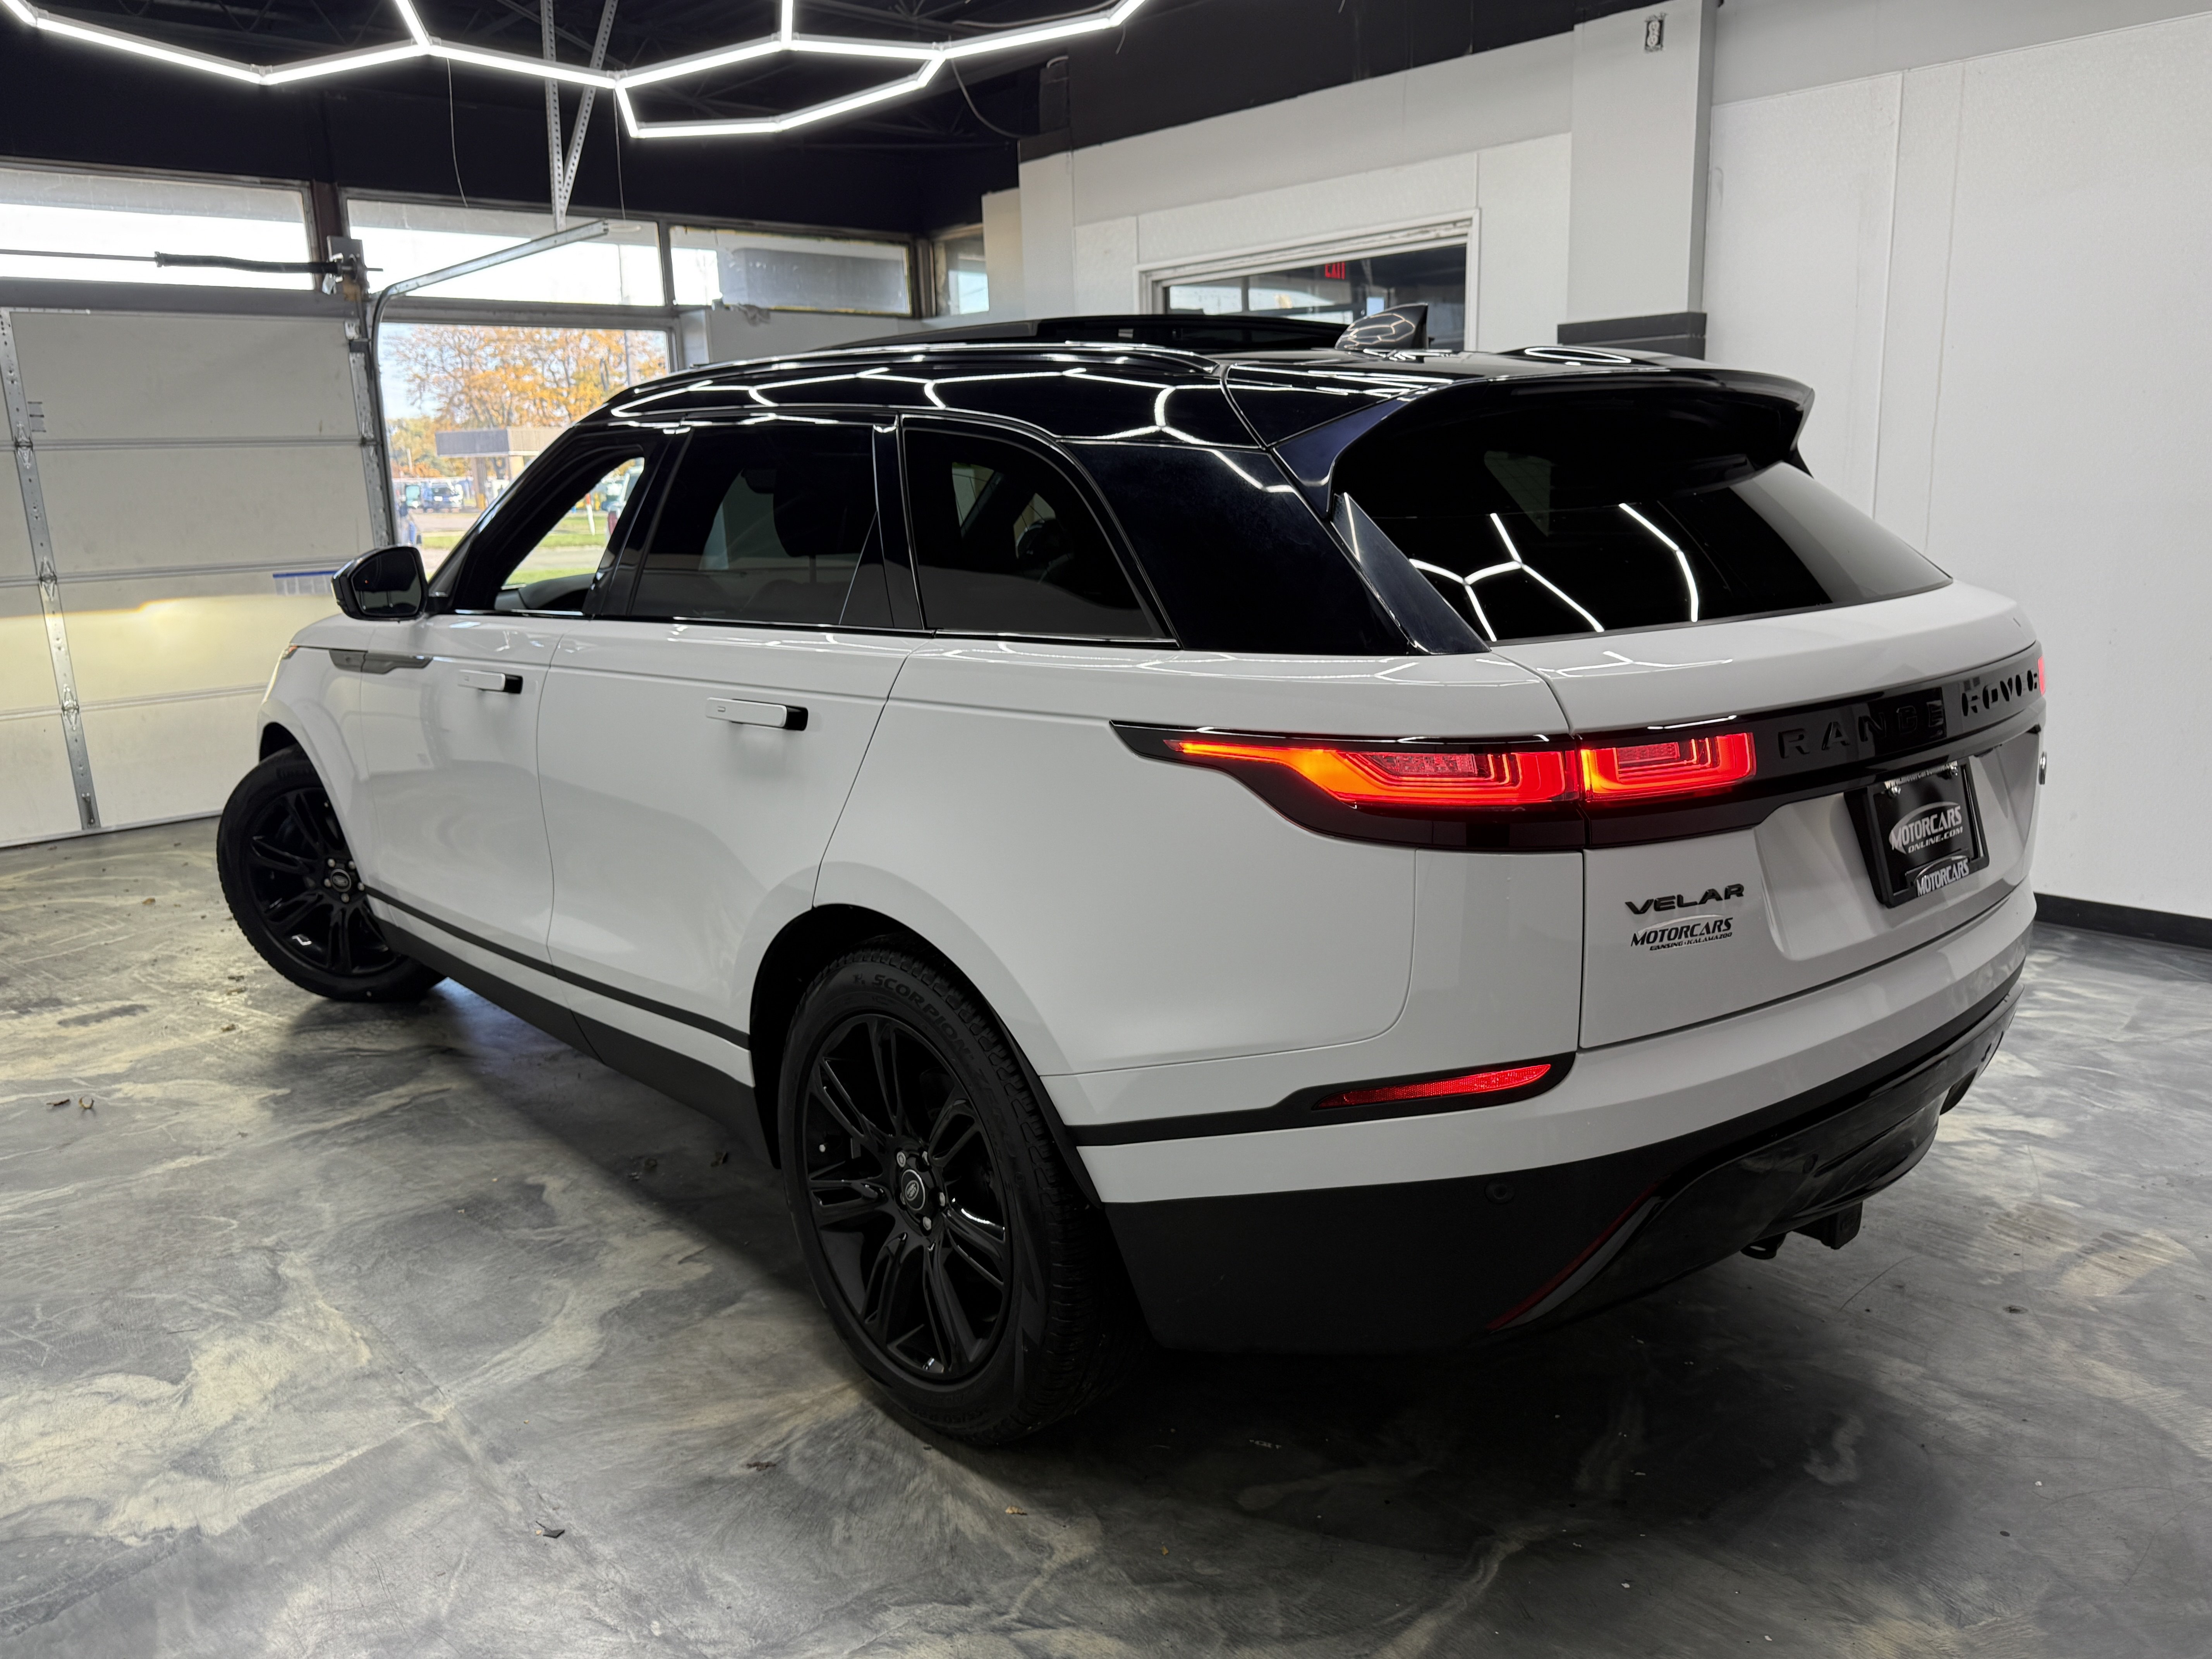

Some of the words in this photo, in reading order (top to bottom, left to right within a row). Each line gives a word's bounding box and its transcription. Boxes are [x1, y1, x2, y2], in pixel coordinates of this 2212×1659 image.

[1778, 700, 1945, 759] RANGE
[1891, 805, 1962, 850] MOTORCARS
[1908, 826, 1963, 854] ONLINE.COM
[1916, 858, 1970, 897] MOTORCARS
[1625, 883, 1744, 915] VELAR
[1630, 917, 1733, 947] MOTORCARS
[872, 974, 972, 1055] SCORPION
